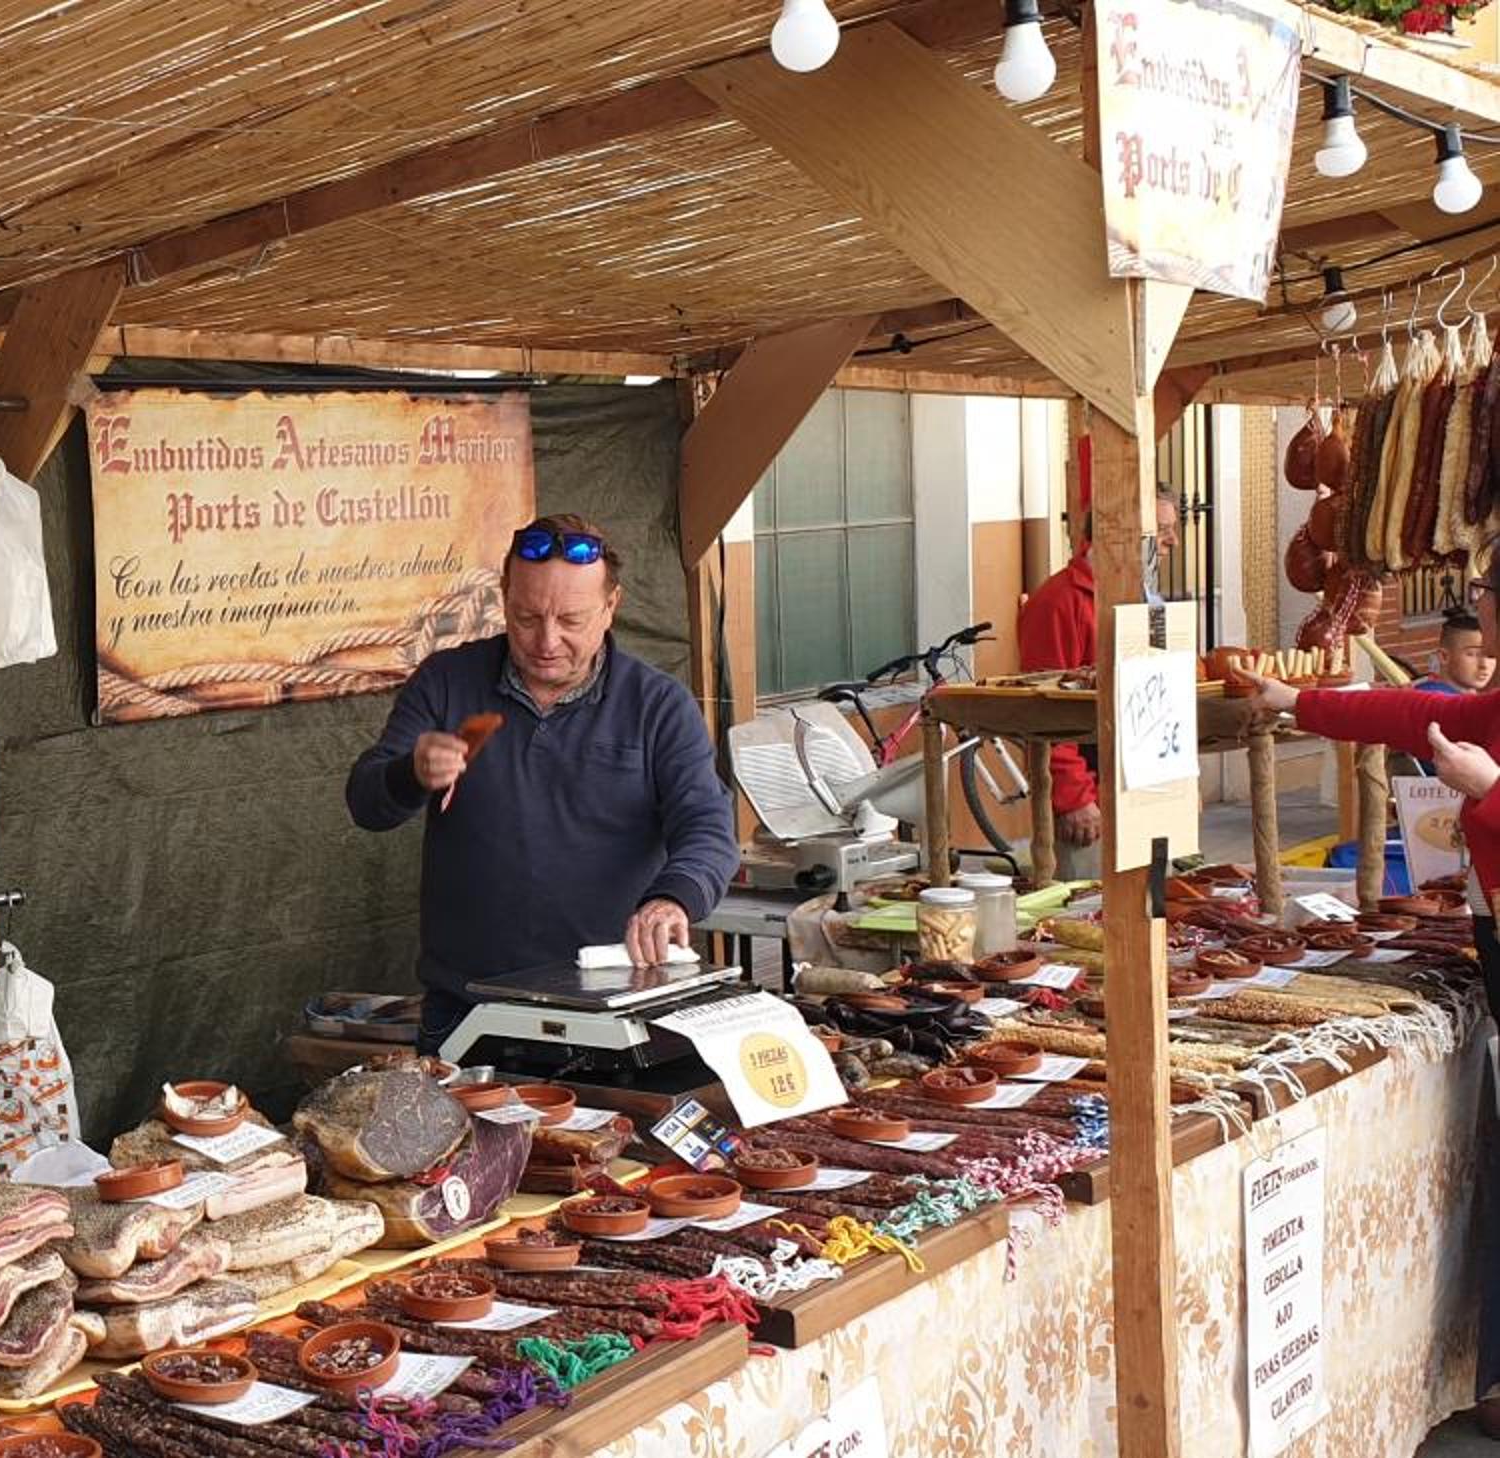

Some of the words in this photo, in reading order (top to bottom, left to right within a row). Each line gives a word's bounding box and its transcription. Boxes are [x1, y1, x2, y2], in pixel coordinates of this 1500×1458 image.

[1115, 131, 1192, 199] Ports
[94, 415, 264, 475] Embutidos
[272, 415, 411, 471] Artesanos
[166, 492, 261, 545] Ports
[273, 490, 306, 529] de
[316, 485, 451, 527] Castellón
[110, 555, 164, 600] Con
[170, 560, 201, 595] las
[208, 562, 279, 592] recetas
[286, 550, 310, 585] de
[318, 554, 394, 584] nuestros
[400, 543, 464, 577] abuelos
[108, 616, 125, 652] y
[133, 600, 213, 634] nuestra
[219, 589, 362, 638] imaginación.
[1409, 786, 1445, 800] LOTE
[1263, 1256, 1303, 1297] CEBOLLA
[1275, 1302, 1293, 1329] AJO
